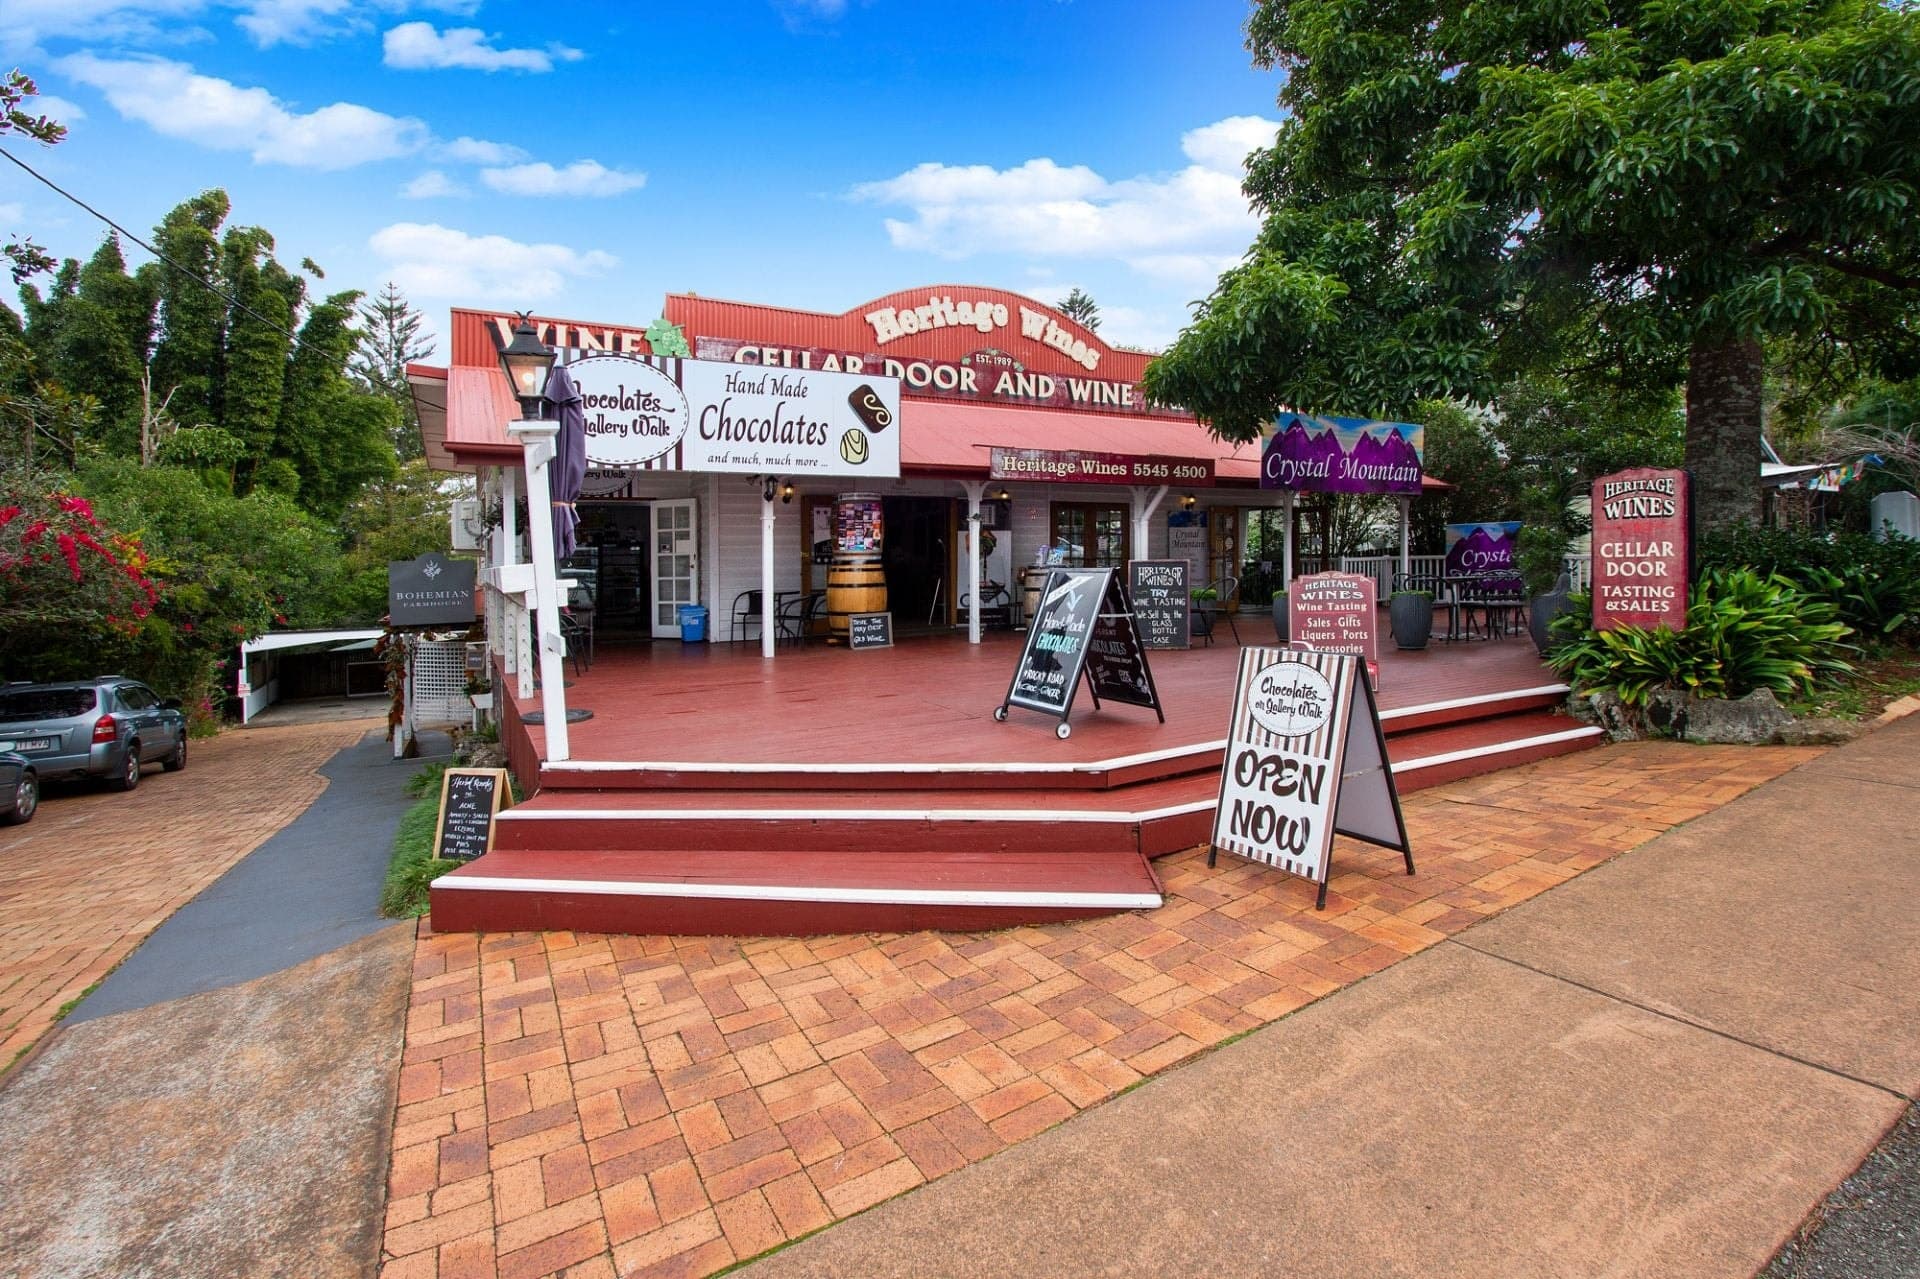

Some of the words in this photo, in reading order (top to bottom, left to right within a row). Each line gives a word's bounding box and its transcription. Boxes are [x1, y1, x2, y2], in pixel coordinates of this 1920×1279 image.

[865, 296, 1009, 345] Heritage
[1019, 305, 1101, 371] Wines
[976, 354, 992, 365] EST.
[994, 356, 1012, 367] 1989
[725, 371, 769, 395] Hand
[771, 374, 808, 398] Made
[884, 359, 979, 392] DOOR
[997, 371, 1056, 399] AND
[1069, 378, 1134, 406] WINE
[573, 380, 675, 413] hocolates
[632, 414, 671, 437] Walk
[700, 397, 829, 445] Chocolates
[707, 451, 728, 464] and
[732, 452, 762, 466] much,
[765, 453, 791, 466] much
[795, 457, 819, 467] more
[1002, 456, 1076, 477] Heritage
[1081, 460, 1127, 475] Wines
[1133, 463, 1169, 477] 5545
[1172, 464, 1207, 479] 4500
[1266, 453, 1335, 484] Crystal
[1338, 457, 1418, 482] Mountain
[1604, 478, 1675, 500] HERITAGE
[1604, 496, 1675, 519] WINES
[1600, 541, 1675, 558] CELLAR
[1137, 566, 1183, 586] HERITAGE
[1606, 561, 1668, 577] DOOR
[1146, 574, 1174, 586] WINES
[1305, 580, 1358, 590] HERITAGE
[396, 590, 469, 600] BOHEMIAN
[1150, 588, 1169, 598] TRY
[1300, 590, 1364, 600] WINES
[1601, 585, 1675, 598] TASTING
[403, 600, 463, 608] FARMHOUSE
[1133, 598, 1150, 606] WINE
[1153, 597, 1186, 606] TASTING
[1296, 603, 1323, 611] Wine
[1327, 602, 1368, 612] Tasting
[1605, 599, 1670, 612] &SALES
[1307, 617, 1331, 628] Sales
[1338, 617, 1361, 627] Gifts
[1152, 627, 1177, 635] BOTTLE
[1301, 630, 1336, 641] Liquers
[1343, 630, 1368, 640] Ports
[1152, 636, 1170, 644] CASE
[1261, 676, 1327, 702] Chocolates
[1255, 700, 1265, 710] on
[1298, 701, 1323, 719] Walk
[1235, 750, 1326, 805] OPEN
[459, 802, 476, 810] ACNE
[1230, 799, 1311, 856] NOW
